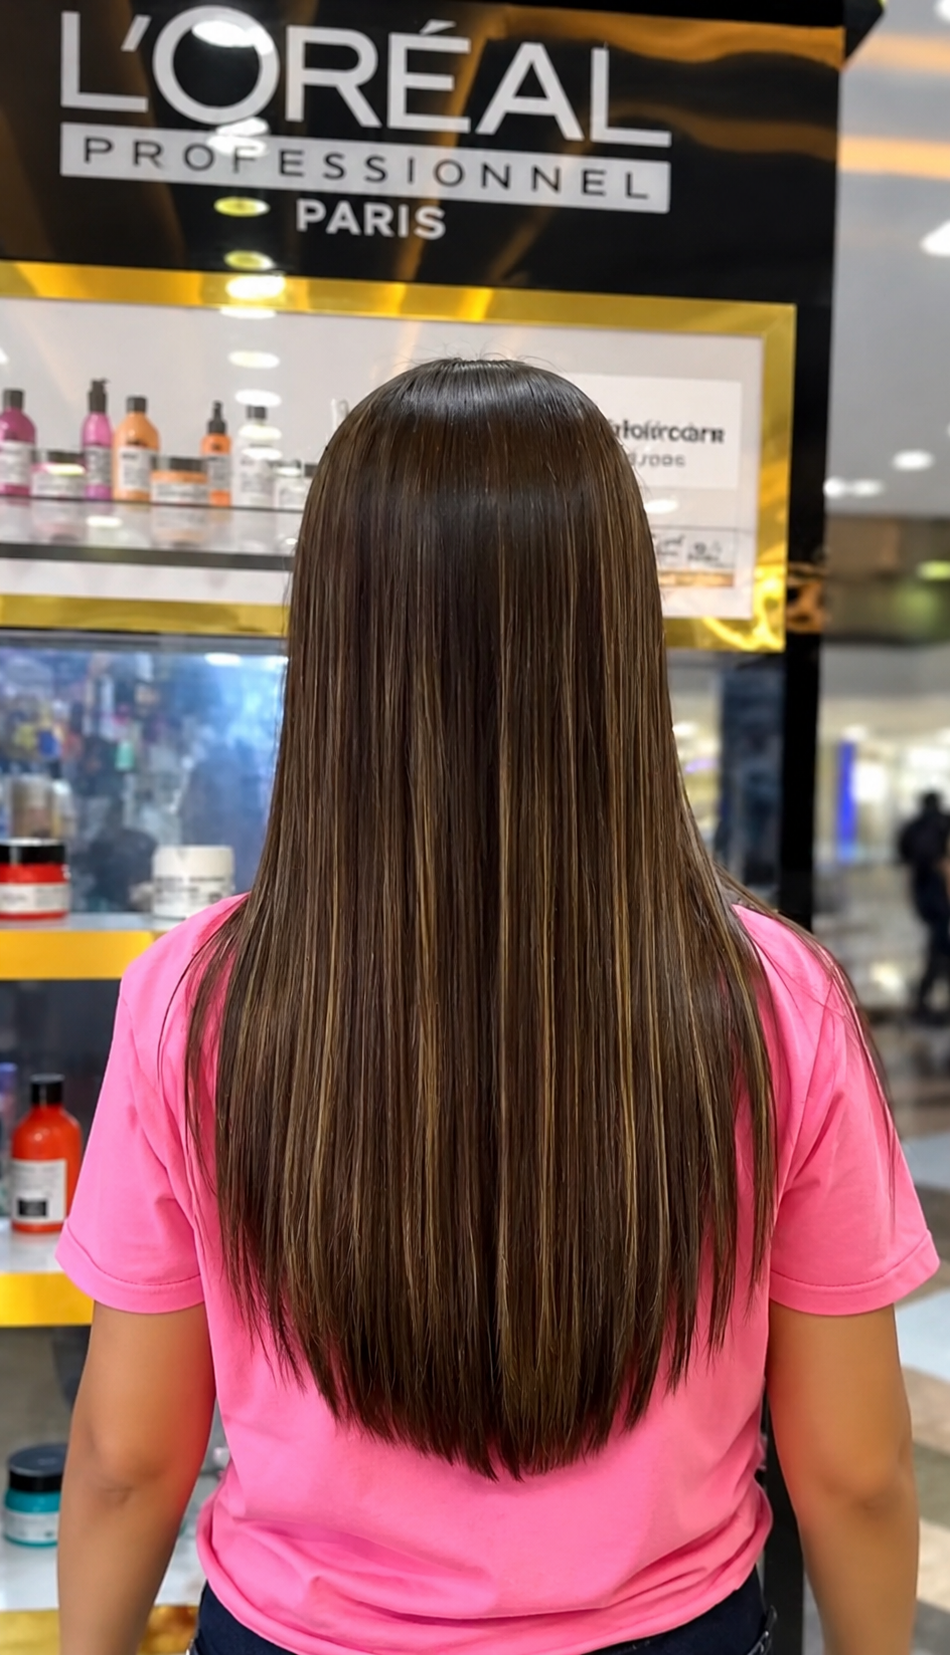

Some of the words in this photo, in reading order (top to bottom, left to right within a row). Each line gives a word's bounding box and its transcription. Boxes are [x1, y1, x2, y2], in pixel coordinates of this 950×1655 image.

[61, 5, 671, 147] L'ORÉAL
[84, 136, 648, 200] PROFESSIONNEL
[296, 199, 446, 240] PARIS
